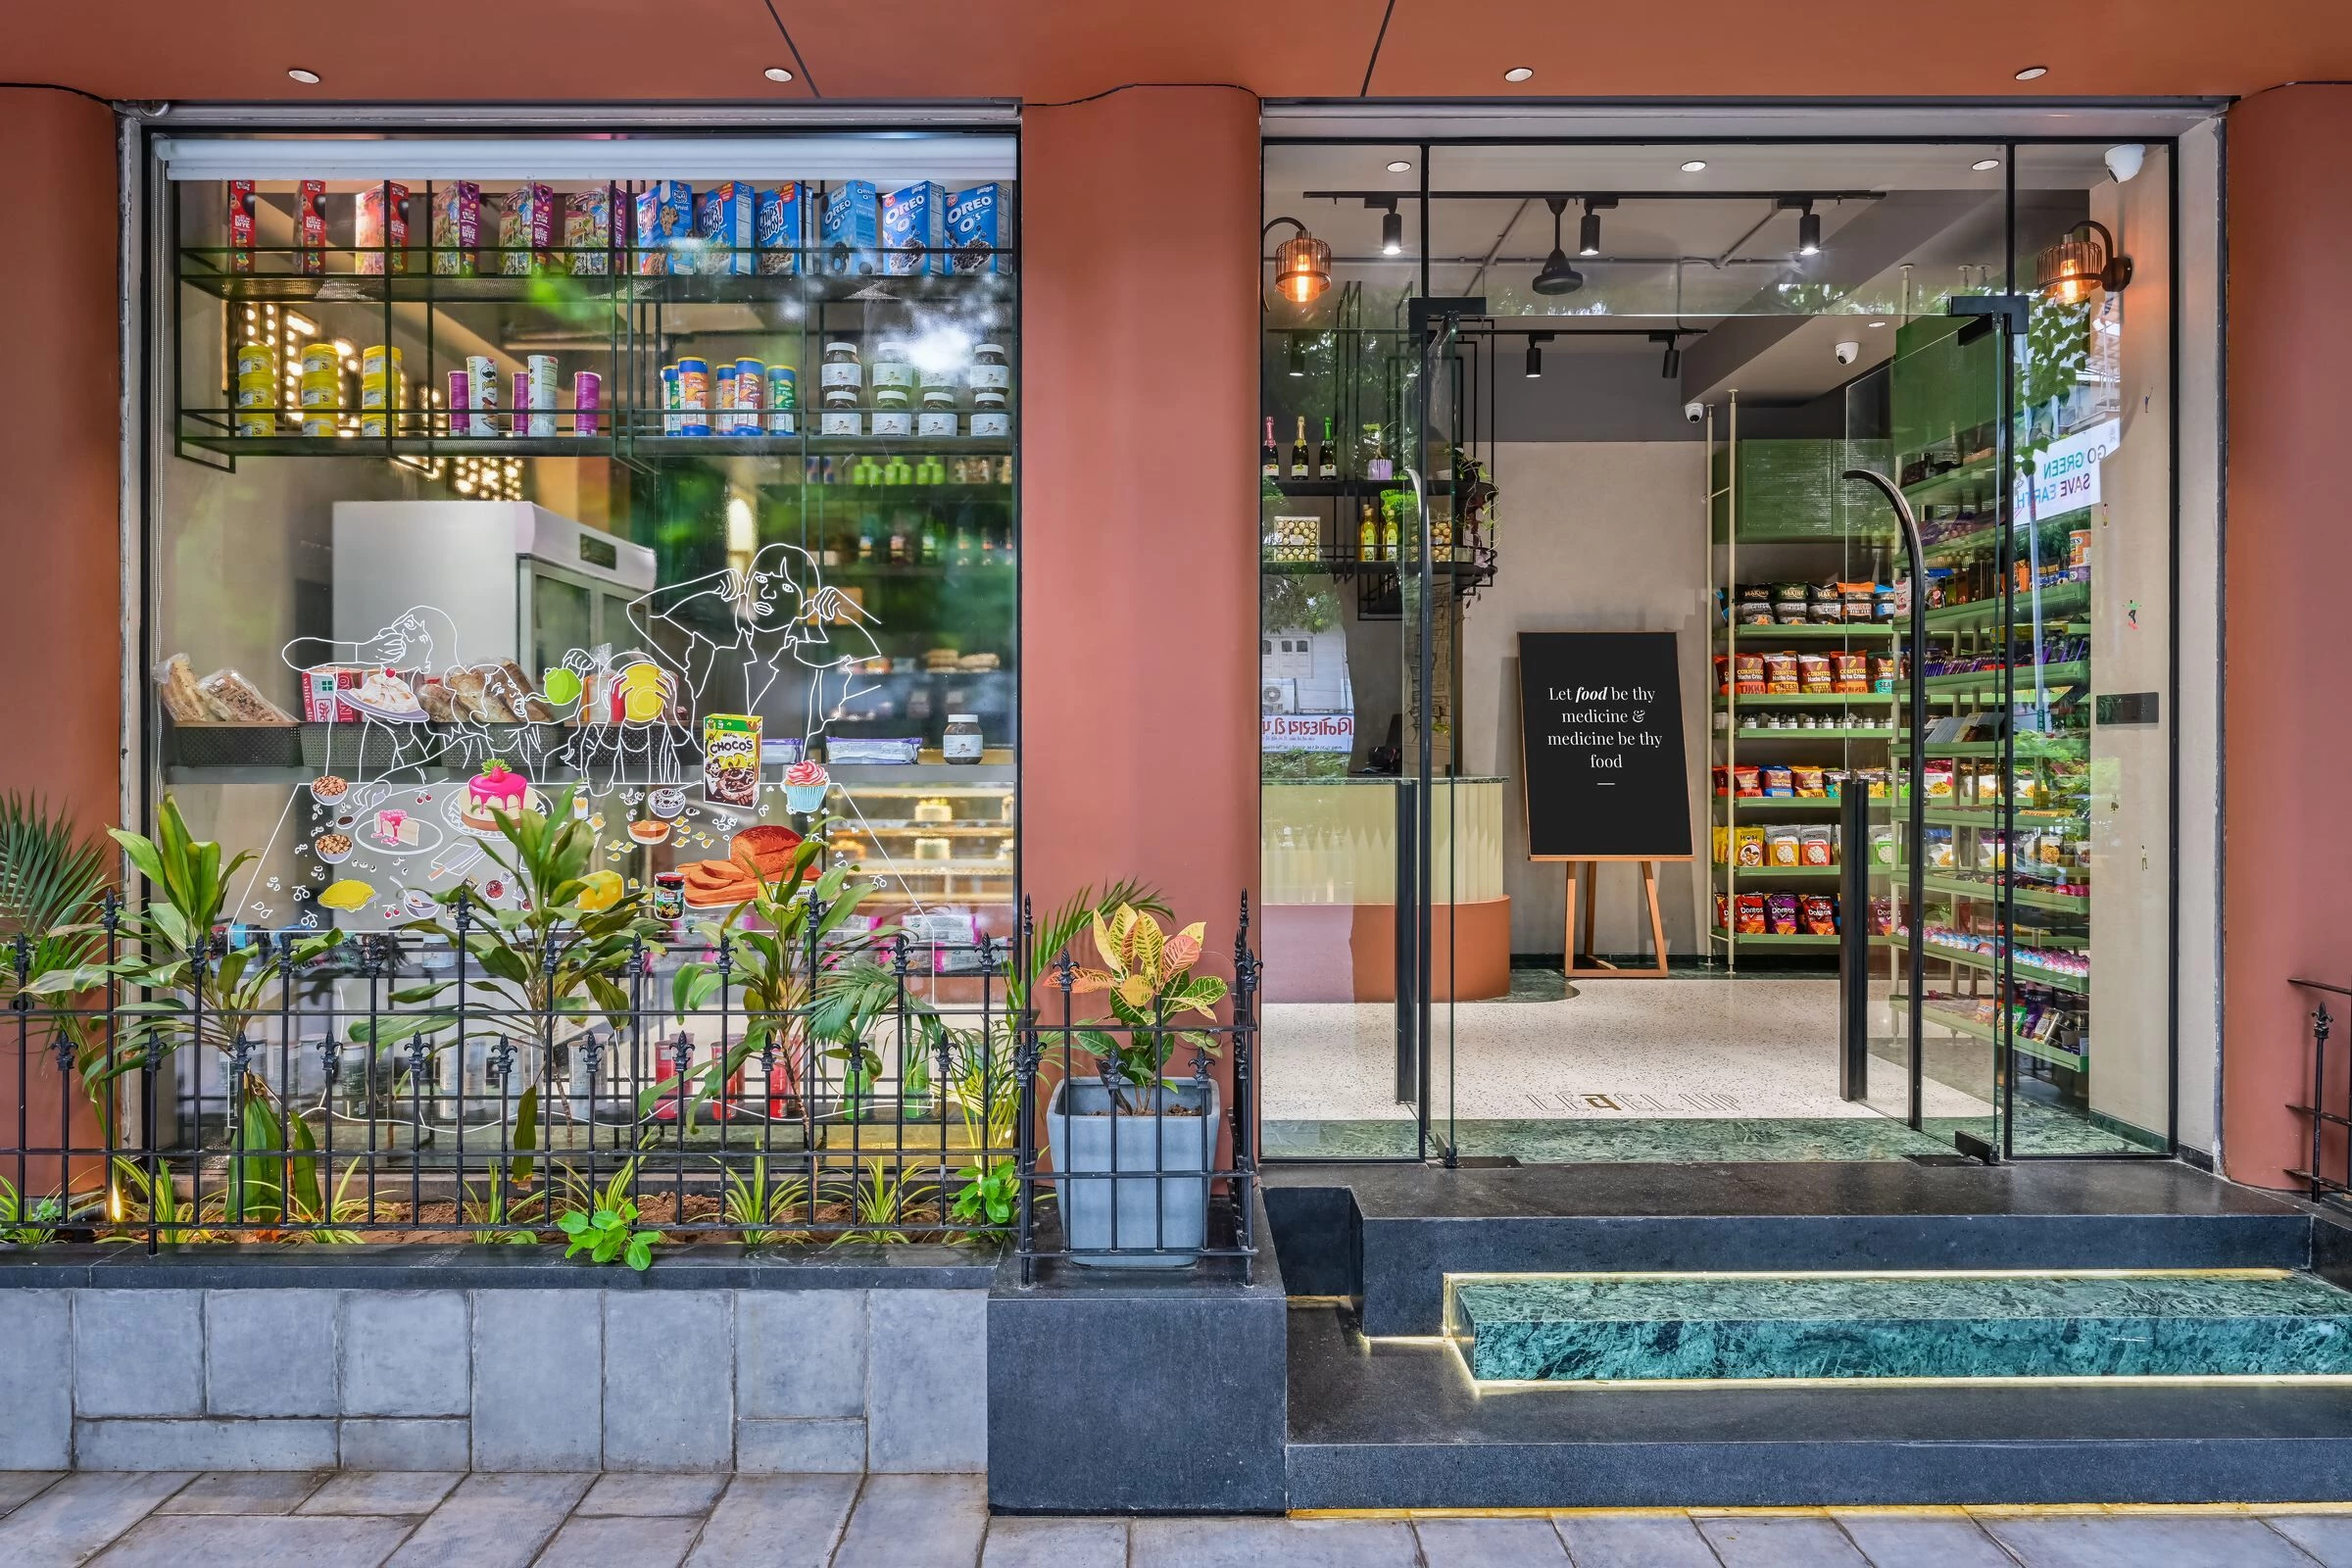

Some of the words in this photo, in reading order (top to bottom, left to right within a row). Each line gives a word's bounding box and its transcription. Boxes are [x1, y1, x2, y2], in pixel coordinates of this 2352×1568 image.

[825, 199, 852, 224] OREO
[885, 195, 924, 225] OREO
[947, 196, 992, 224] OREO
[303, 677, 312, 704] white
[1548, 687, 1573, 701] Let
[1575, 686, 1608, 703] food
[1611, 687, 1629, 701] be
[1633, 687, 1655, 703] thy
[1562, 710, 1628, 722] medicine
[1632, 710, 1645, 722] &
[710, 740, 754, 754] CHOCOS
[1547, 732, 1614, 746] medicine
[1618, 732, 1636, 746] be
[1640, 732, 1663, 748] thy
[1590, 755, 1623, 768] food
